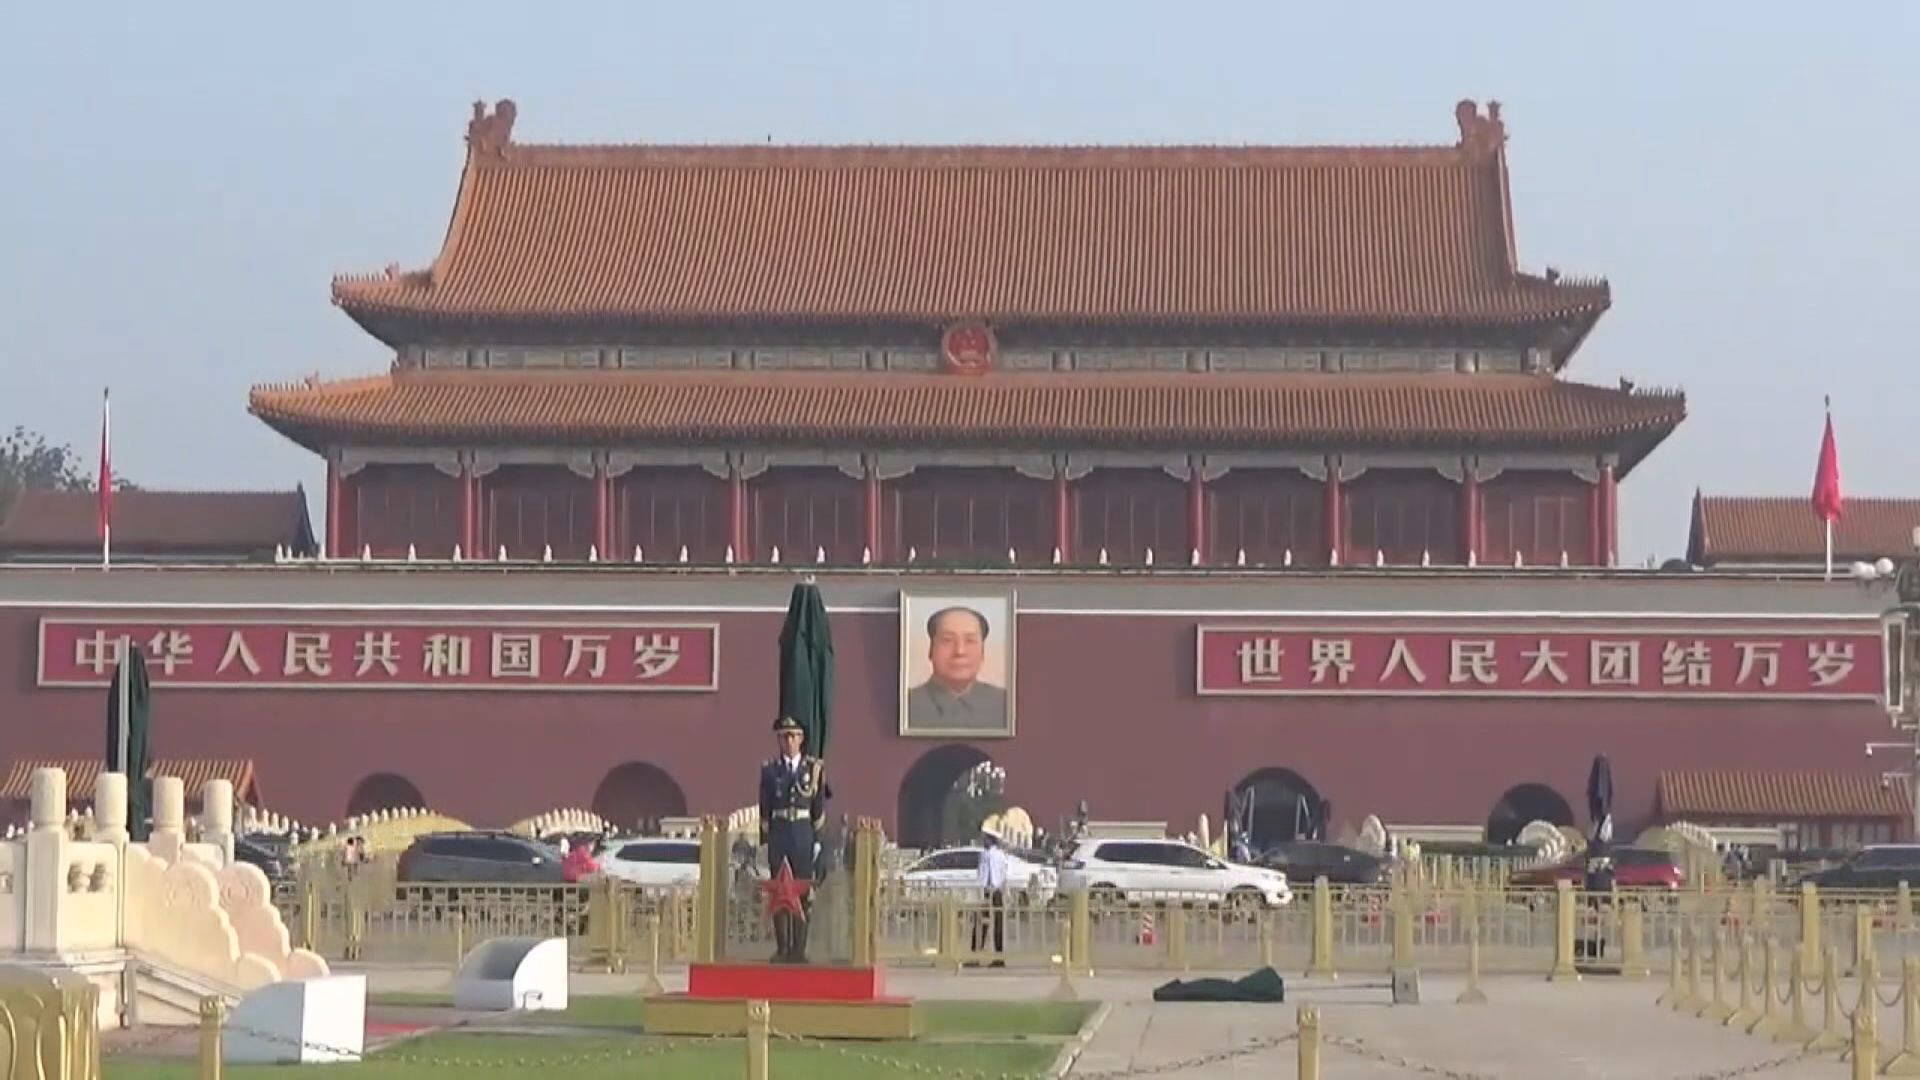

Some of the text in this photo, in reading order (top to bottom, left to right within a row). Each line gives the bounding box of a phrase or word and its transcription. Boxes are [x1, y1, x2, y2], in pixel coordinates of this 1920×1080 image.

[76, 629, 680, 678] 中华人民共和国万岁
[1236, 638, 1855, 687] 世界人民大团结万岁
